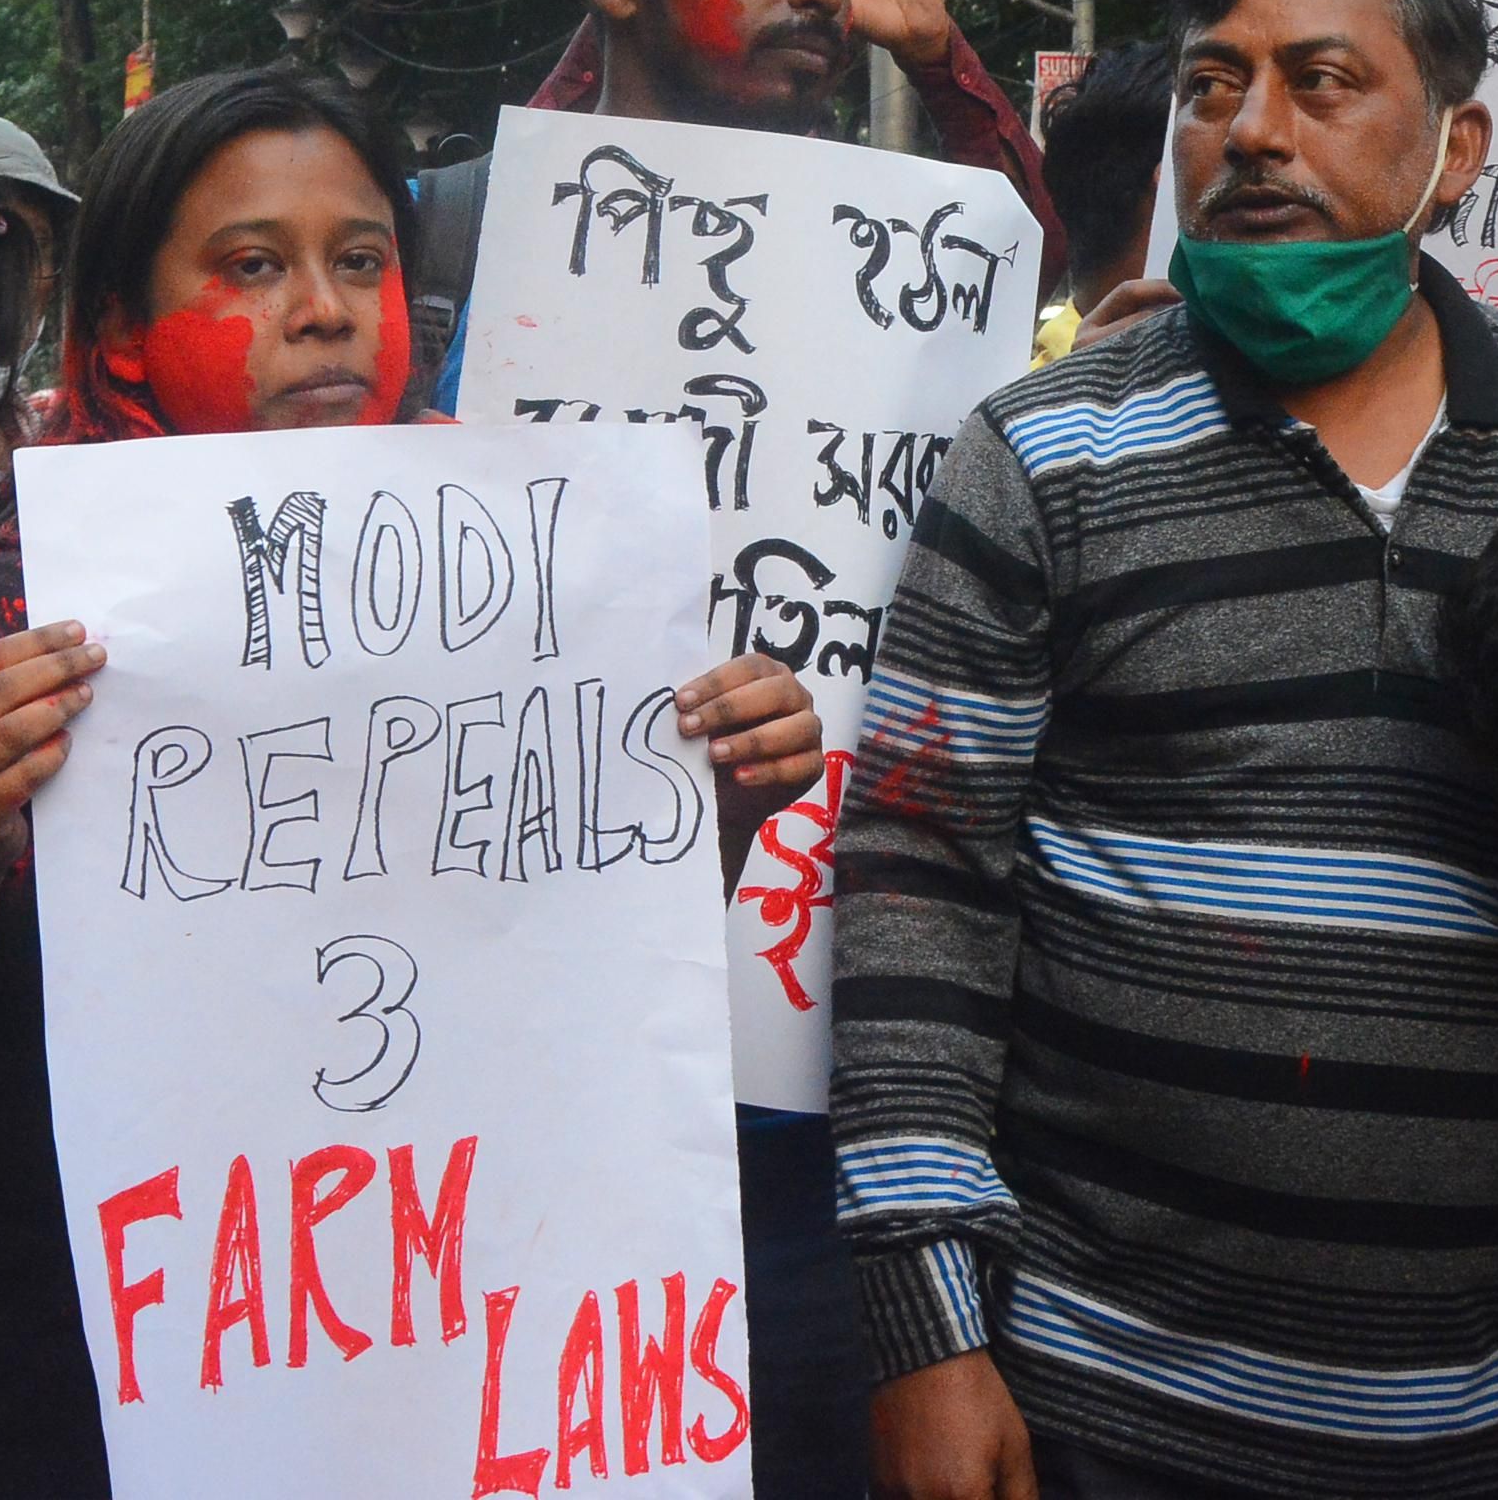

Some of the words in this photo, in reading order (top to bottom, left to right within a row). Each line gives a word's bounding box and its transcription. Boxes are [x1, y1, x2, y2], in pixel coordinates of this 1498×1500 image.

[552, 144, 769, 354] পিছু
[227, 478, 570, 669] MODI
[120, 678, 703, 901] REPEALS
[312, 934, 421, 1112] 3
[98, 1135, 479, 1404] FARM
[472, 1271, 750, 1500] LAWS
